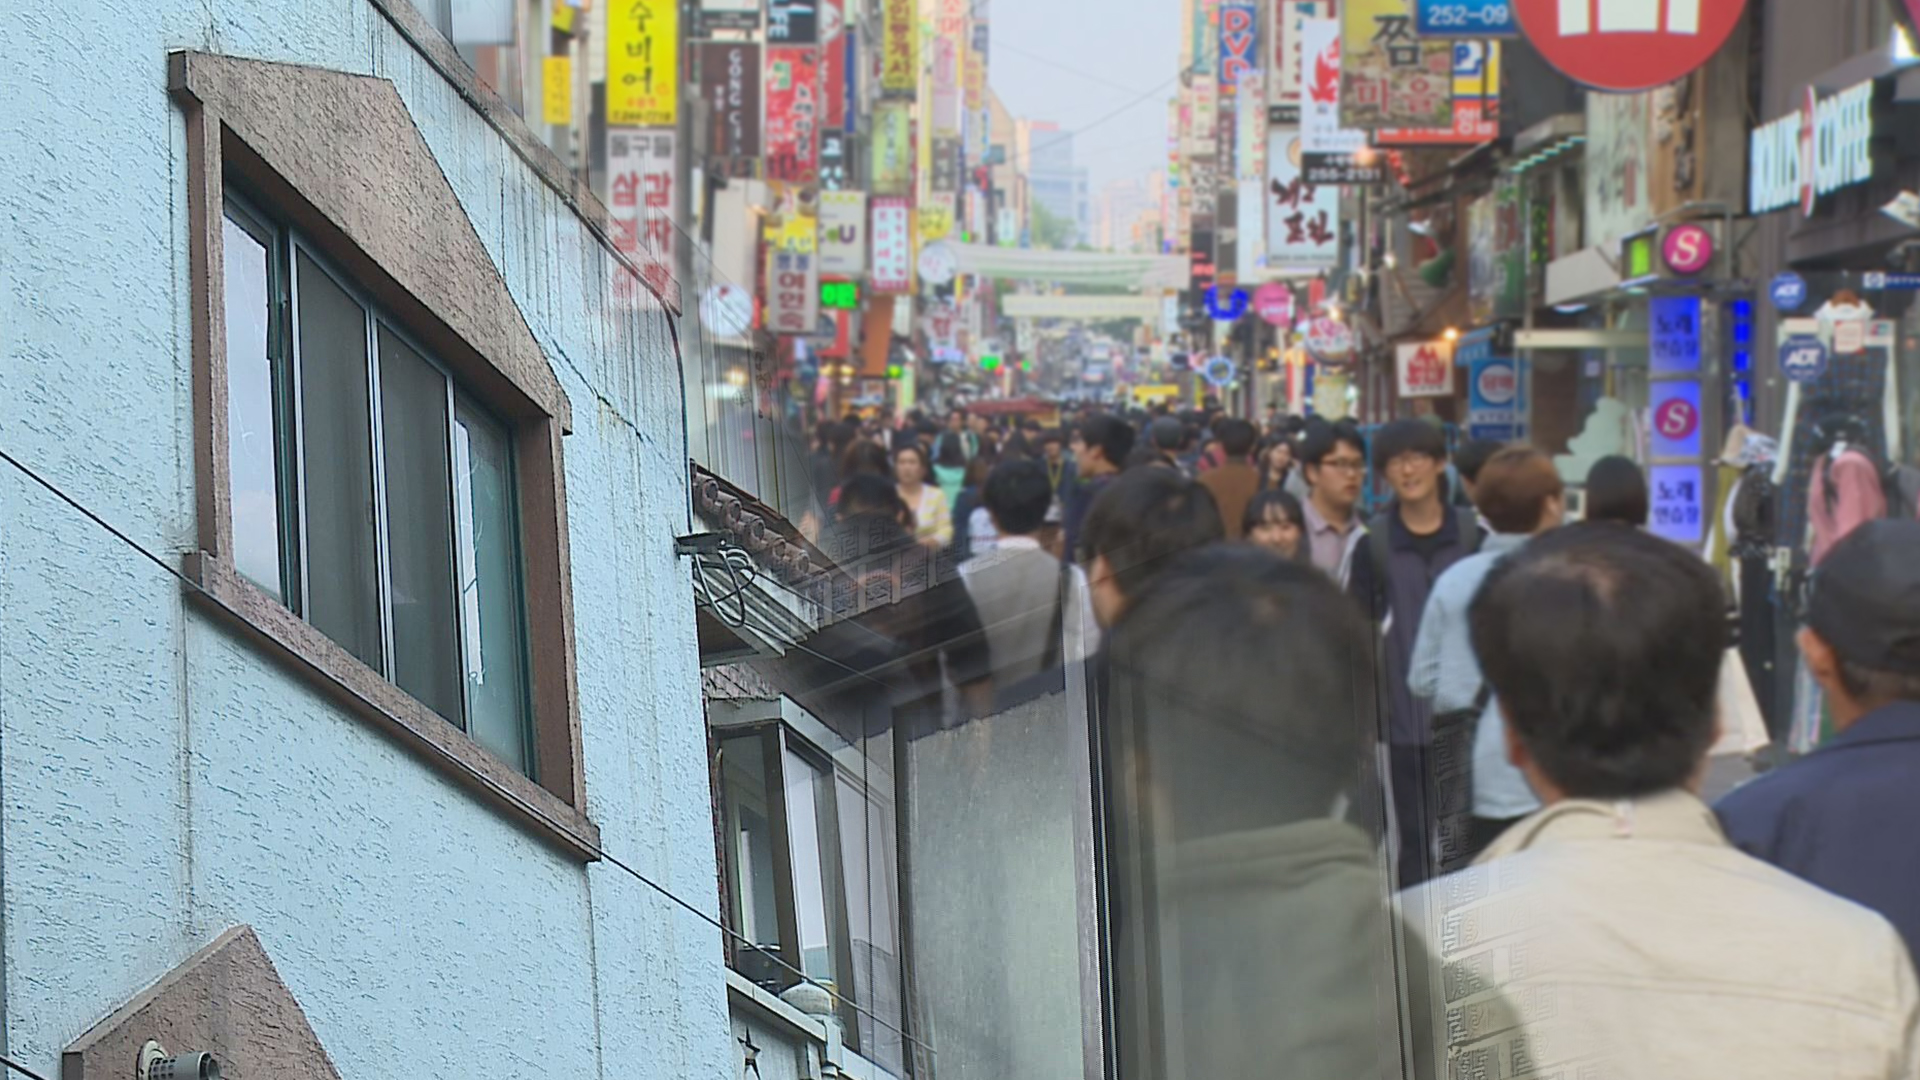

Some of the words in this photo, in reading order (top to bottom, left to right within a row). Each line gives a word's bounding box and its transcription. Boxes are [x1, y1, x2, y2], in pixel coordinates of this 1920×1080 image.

[1428, 6, 1509, 25] 252-09
[621, 1, 653, 95] 수비어
[1223, 11, 1250, 80] DVD
[1373, 15, 1420, 66] 찜
[729, 48, 742, 107] GONG
[1357, 77, 1439, 114] 마을
[1816, 78, 1873, 196] COFFEE
[1671, 232, 1701, 265] S
[778, 273, 806, 330] 여인숙
[1774, 283, 1801, 297] ADT
[1656, 313, 1693, 333] 노래
[1653, 339, 1698, 358] 연습장
[1784, 349, 1820, 366] ADT
[1663, 404, 1689, 433] S
[1657, 481, 1695, 500] 노래
[1653, 506, 1699, 524] 연습장
